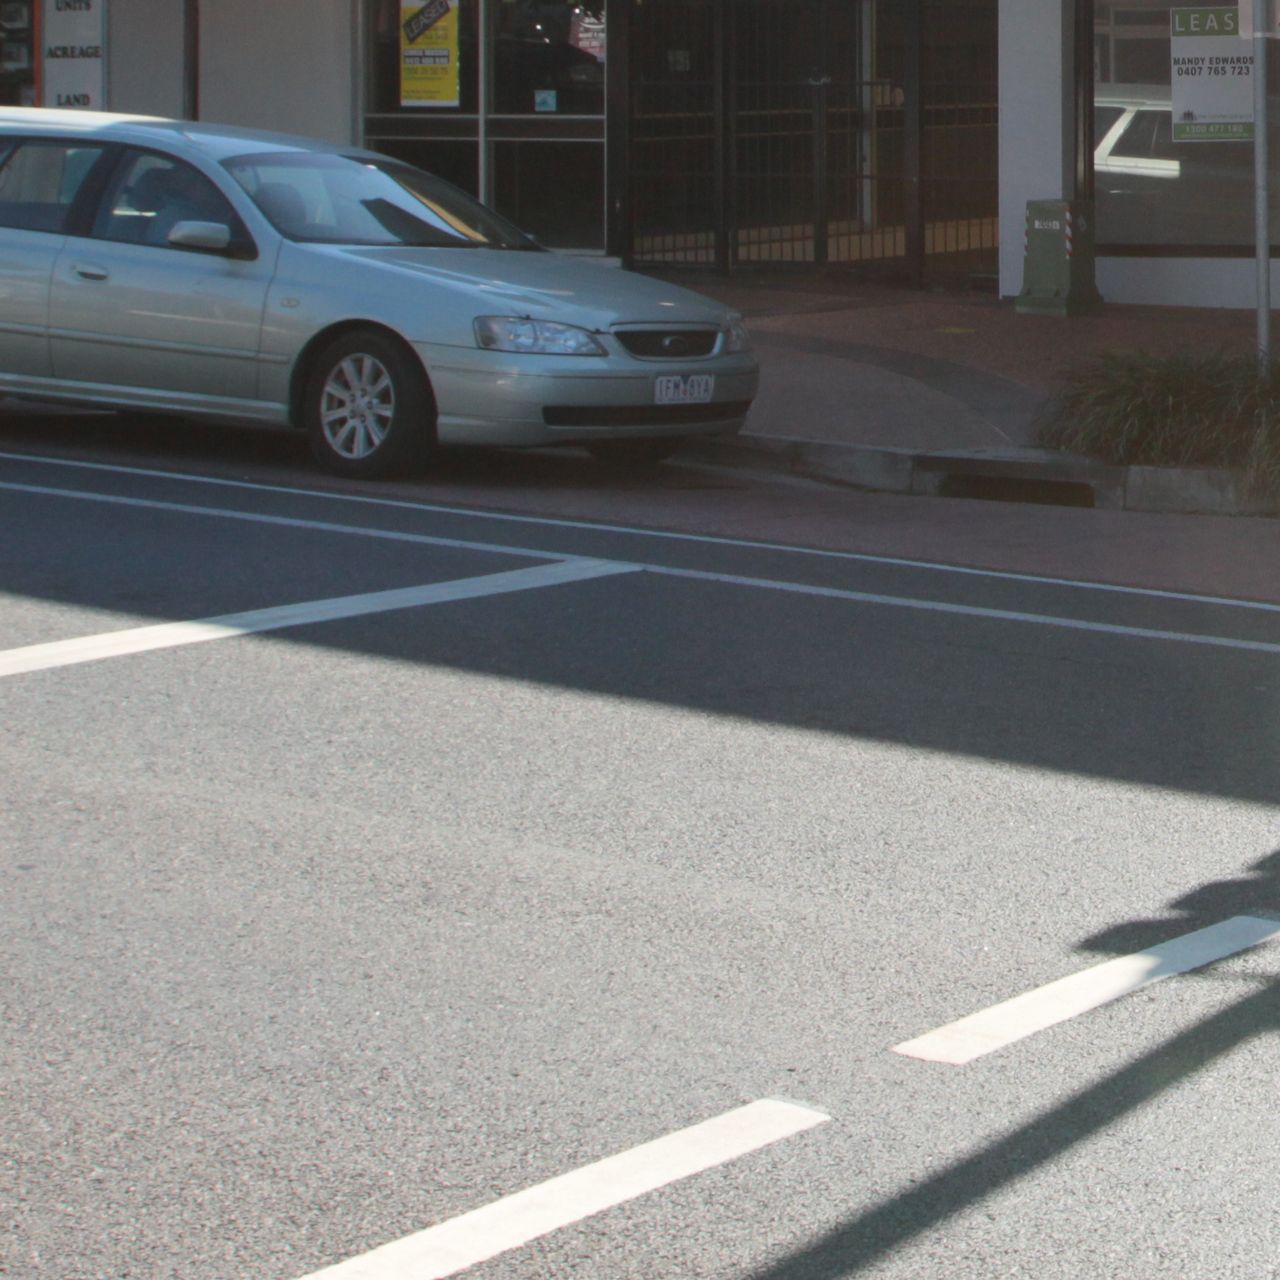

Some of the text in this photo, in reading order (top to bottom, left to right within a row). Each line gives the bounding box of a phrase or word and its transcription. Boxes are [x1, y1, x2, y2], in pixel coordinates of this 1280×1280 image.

[1175, 13, 1235, 32] LEAS
[47, 45, 101, 59] ACREAGE
[1173, 56, 1254, 66] MANDY EDWARDS
[1177, 66, 1251, 76] 0407 765 723
[56, 94, 90, 107] LAND
